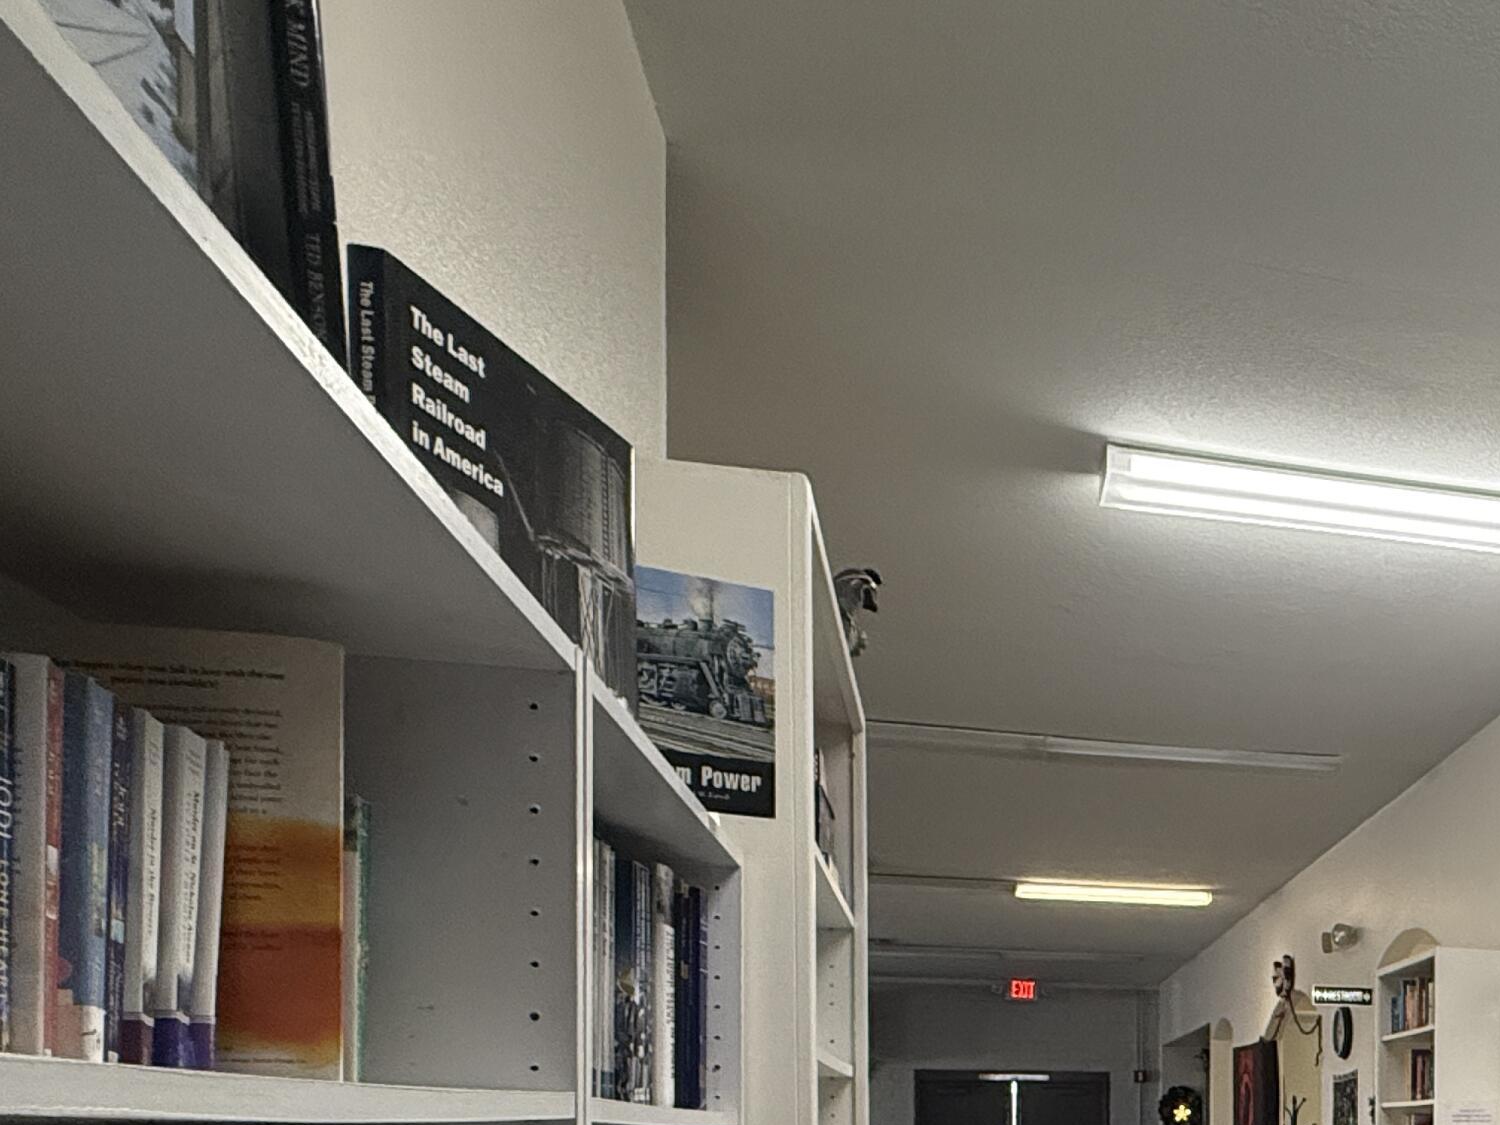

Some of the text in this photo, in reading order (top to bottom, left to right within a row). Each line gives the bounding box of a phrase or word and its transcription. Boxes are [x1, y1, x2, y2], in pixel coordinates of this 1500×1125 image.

[287, 20, 311, 88] MIND
[359, 281, 377, 306] The
[359, 309, 377, 336] Last
[408, 303, 487, 379] The Last
[360, 344, 379, 382] Steam
[410, 344, 471, 404] Steam
[410, 381, 488, 452] Railroad
[410, 420, 505, 498] in America
[700, 764, 762, 793] Power
[1011, 980, 1035, 999] EXIT
